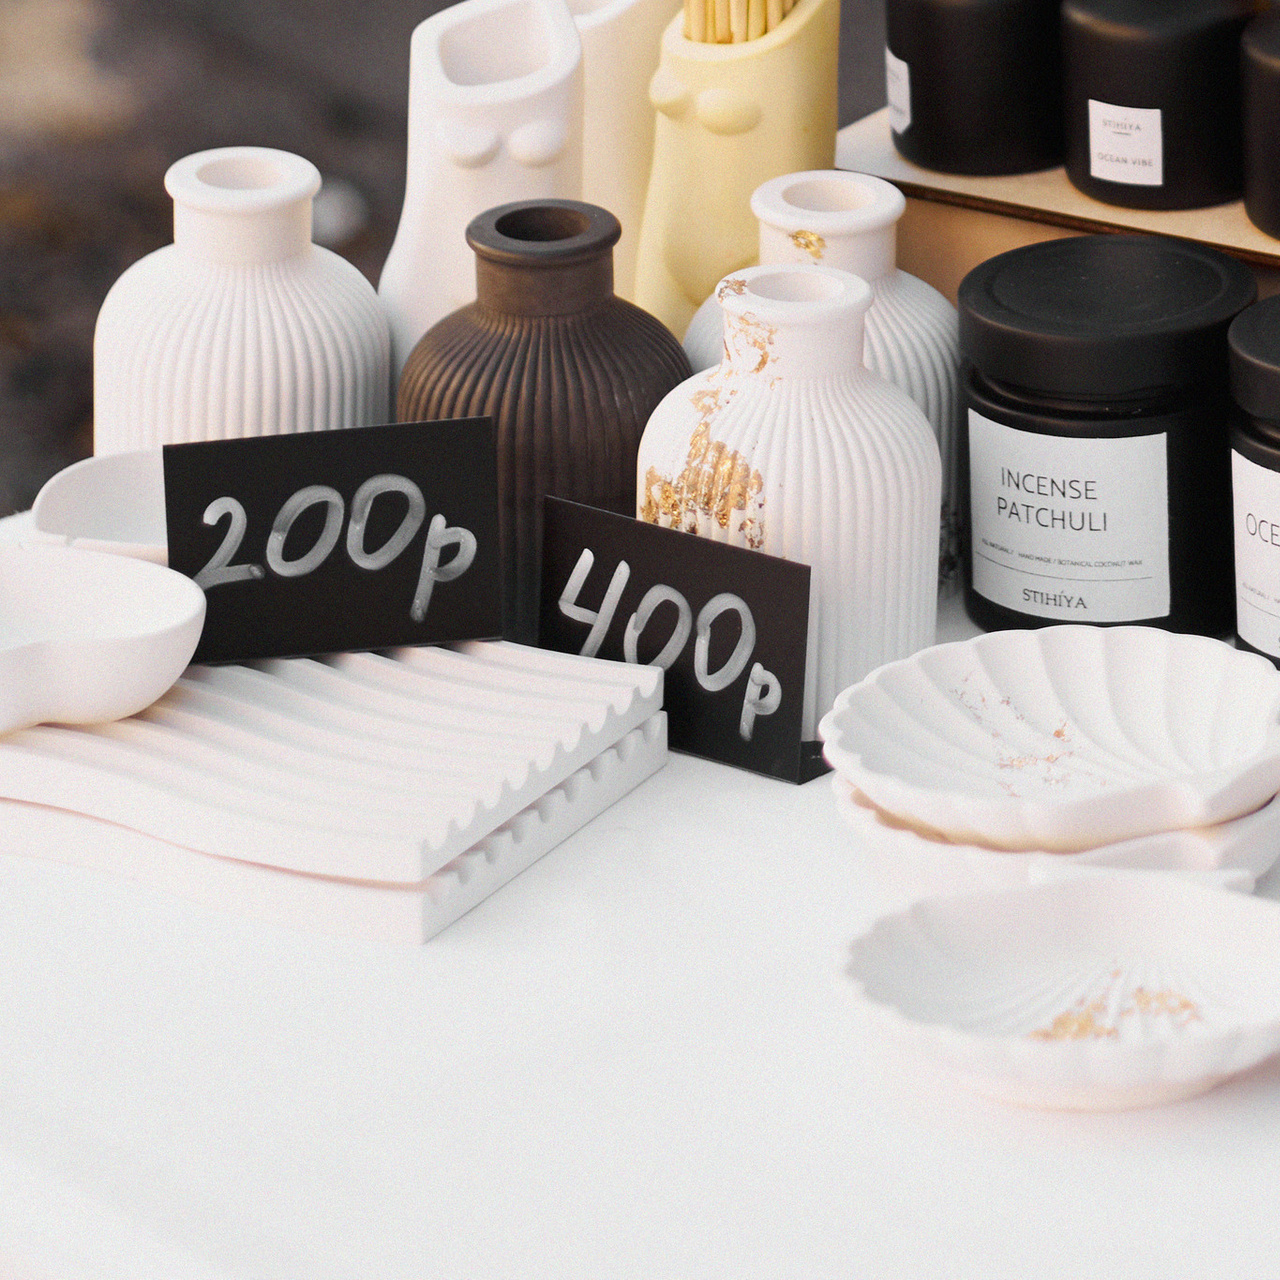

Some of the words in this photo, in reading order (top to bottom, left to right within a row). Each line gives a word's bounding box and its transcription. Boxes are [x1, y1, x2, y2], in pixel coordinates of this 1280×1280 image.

[1001, 467, 1098, 500] INCENSE
[997, 496, 1107, 532] PATCHULI
[1128, 559, 1143, 567] WAX
